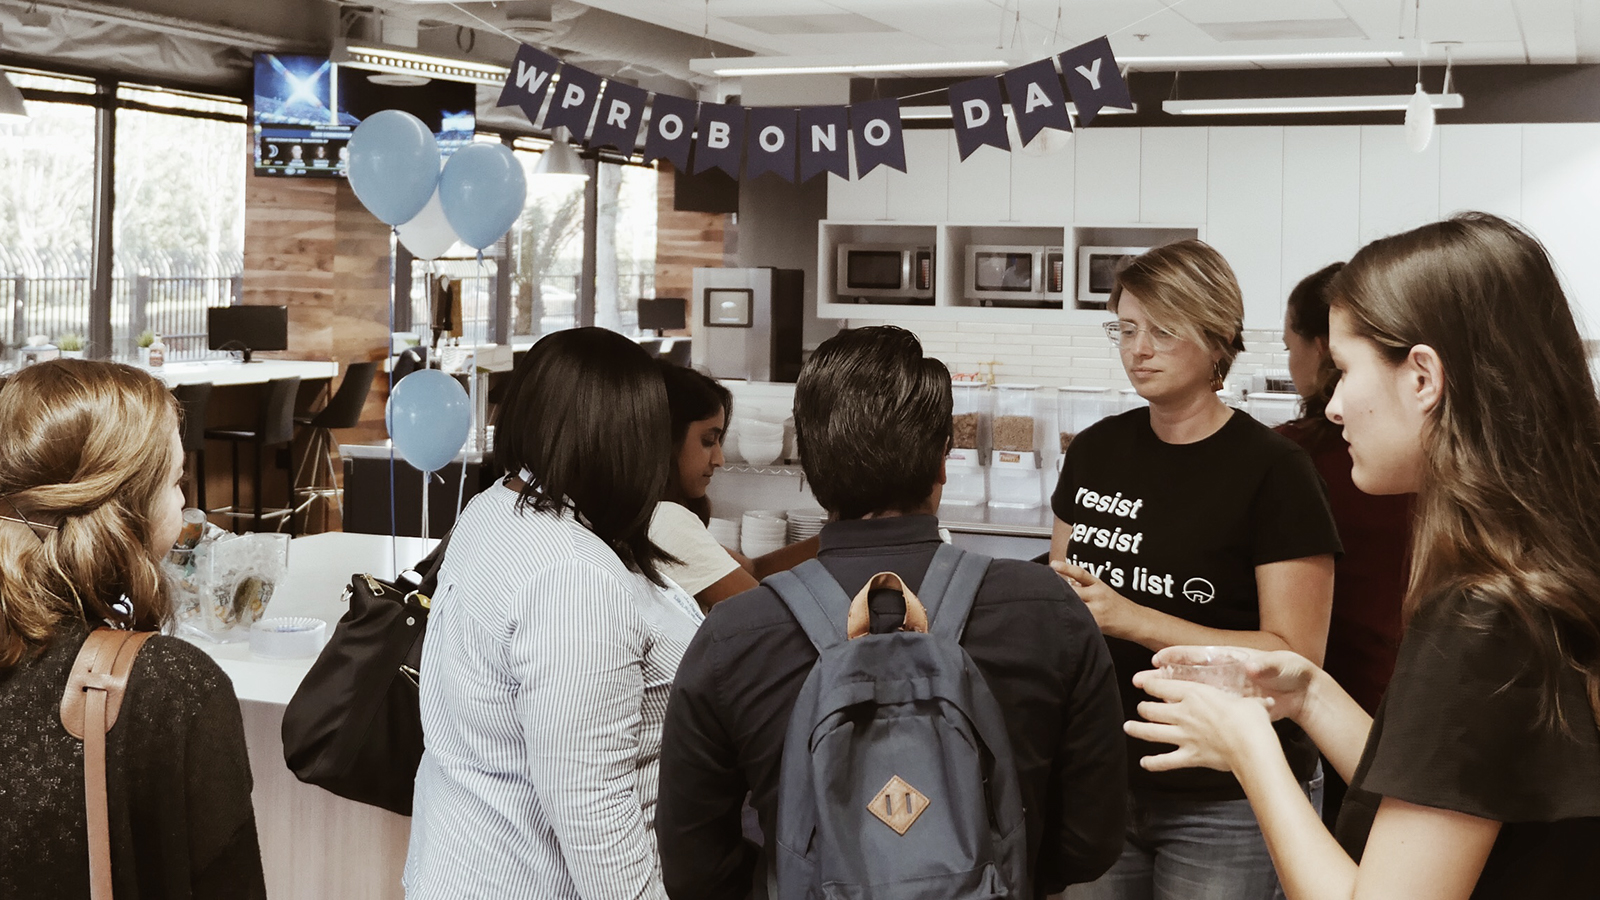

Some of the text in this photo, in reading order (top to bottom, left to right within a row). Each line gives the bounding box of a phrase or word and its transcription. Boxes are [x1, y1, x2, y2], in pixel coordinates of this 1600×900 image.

[963, 58, 1101, 129] DAY
[1075, 487, 1143, 519] resist
[1069, 523, 1143, 554] ersist
[1132, 567, 1174, 598] list
